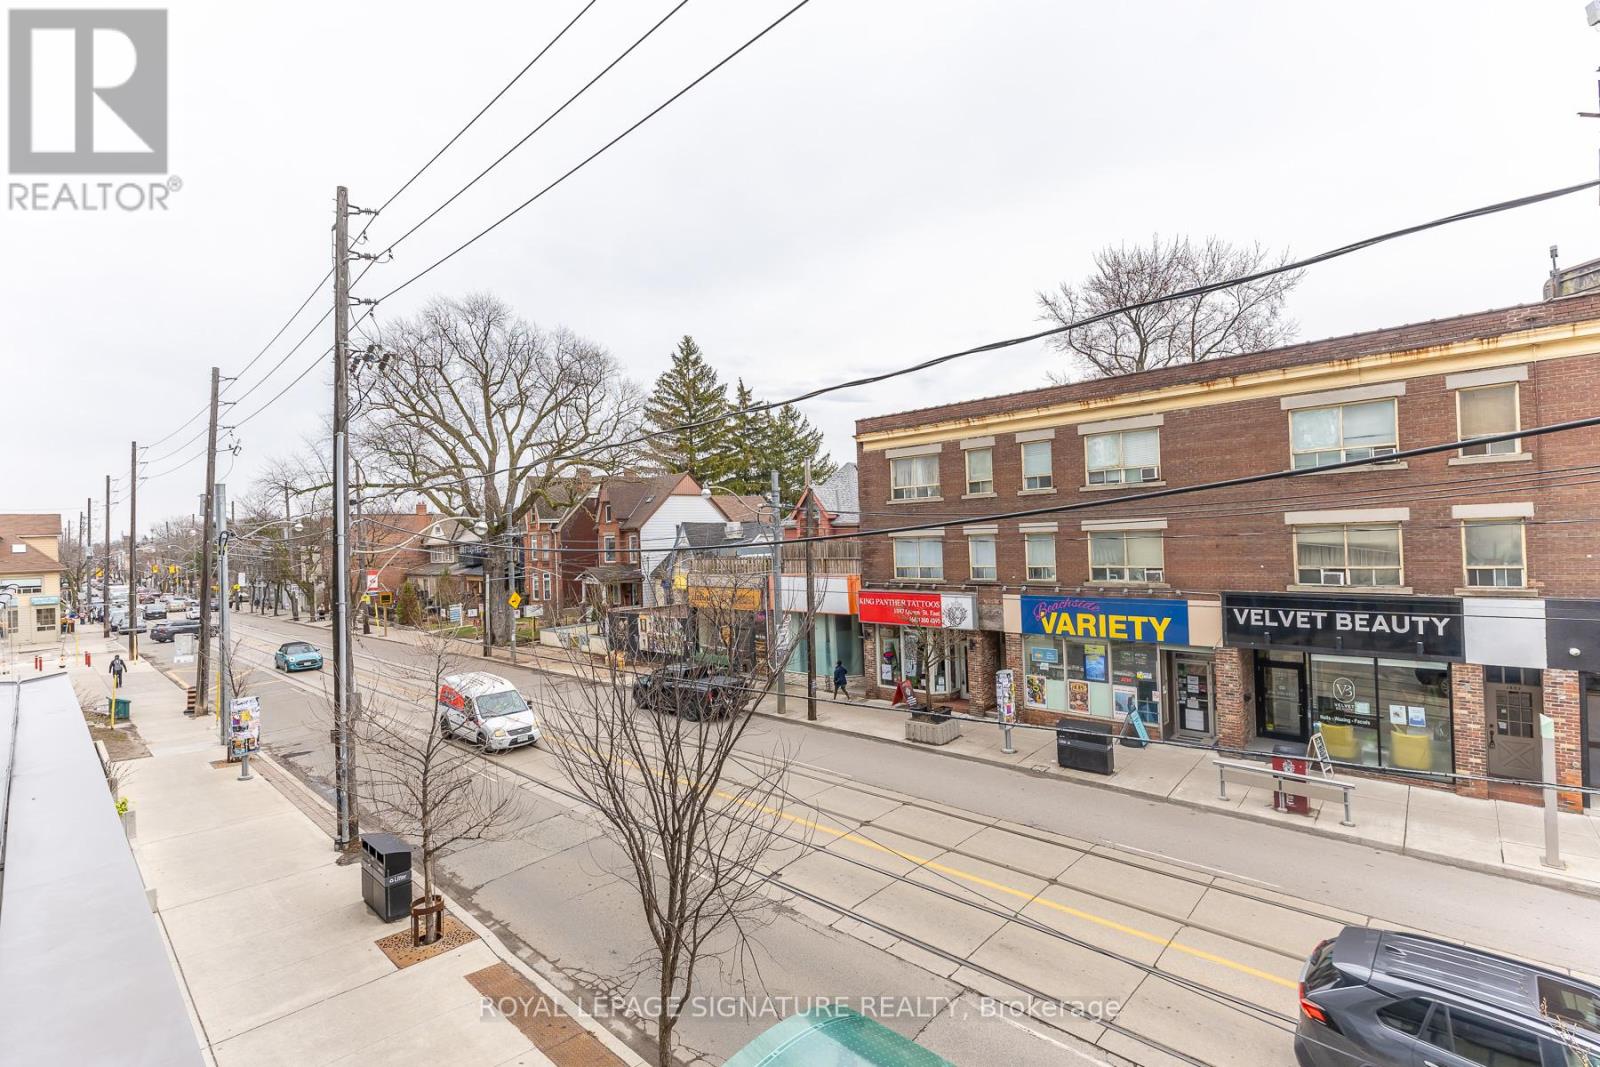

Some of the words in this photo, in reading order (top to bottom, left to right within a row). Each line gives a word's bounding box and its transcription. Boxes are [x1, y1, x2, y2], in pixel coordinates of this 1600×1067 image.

[875, 598, 906, 607] PANTHER
[907, 600, 940, 608] TATTOOS
[1033, 598, 1101, 621] Beachside
[1041, 611, 1172, 641] VARIETY
[1232, 608, 1328, 629] VELVET
[1335, 613, 1451, 636] BEAUTY
